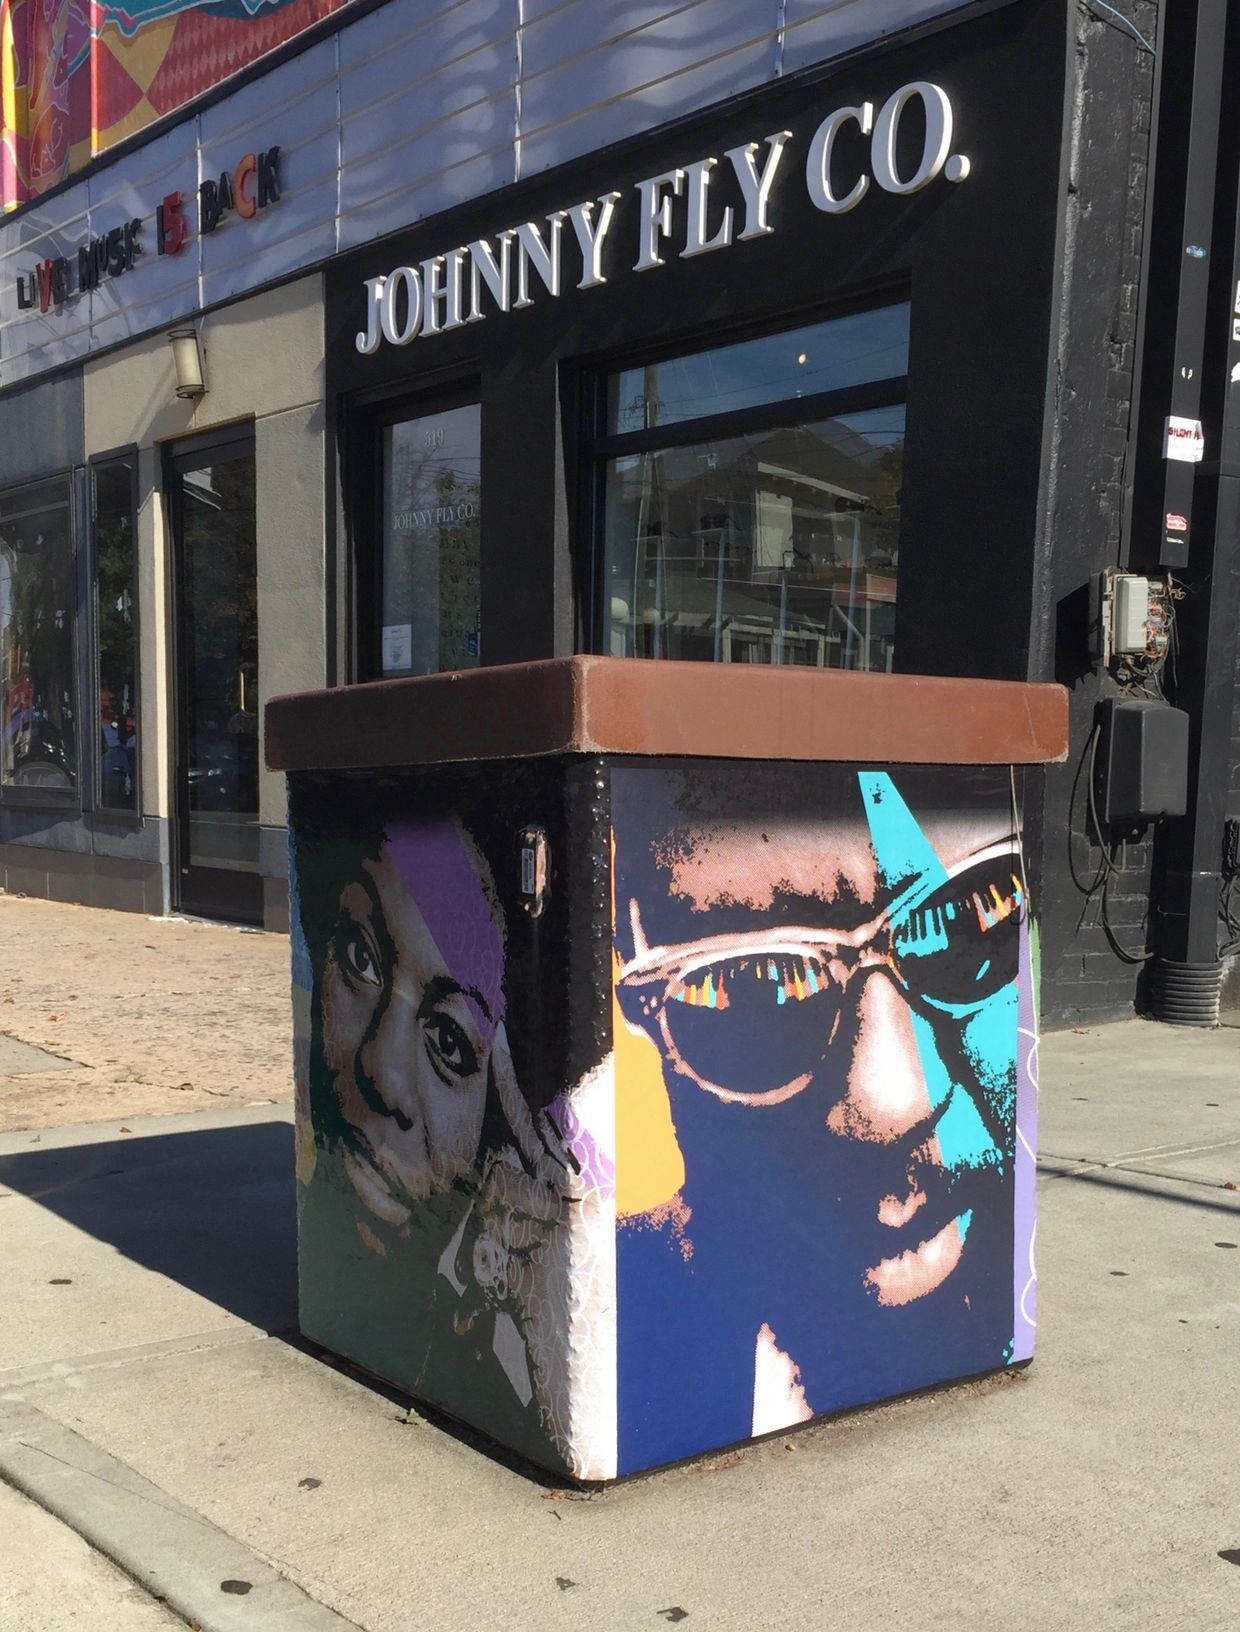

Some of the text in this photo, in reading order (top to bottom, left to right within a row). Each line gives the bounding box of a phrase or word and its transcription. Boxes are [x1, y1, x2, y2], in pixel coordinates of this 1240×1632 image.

[200, 146, 280, 235] BACK
[355, 81, 971, 354] JOHNNY FLY CO.
[393, 502, 476, 530] JOHNNY FLY CO.
